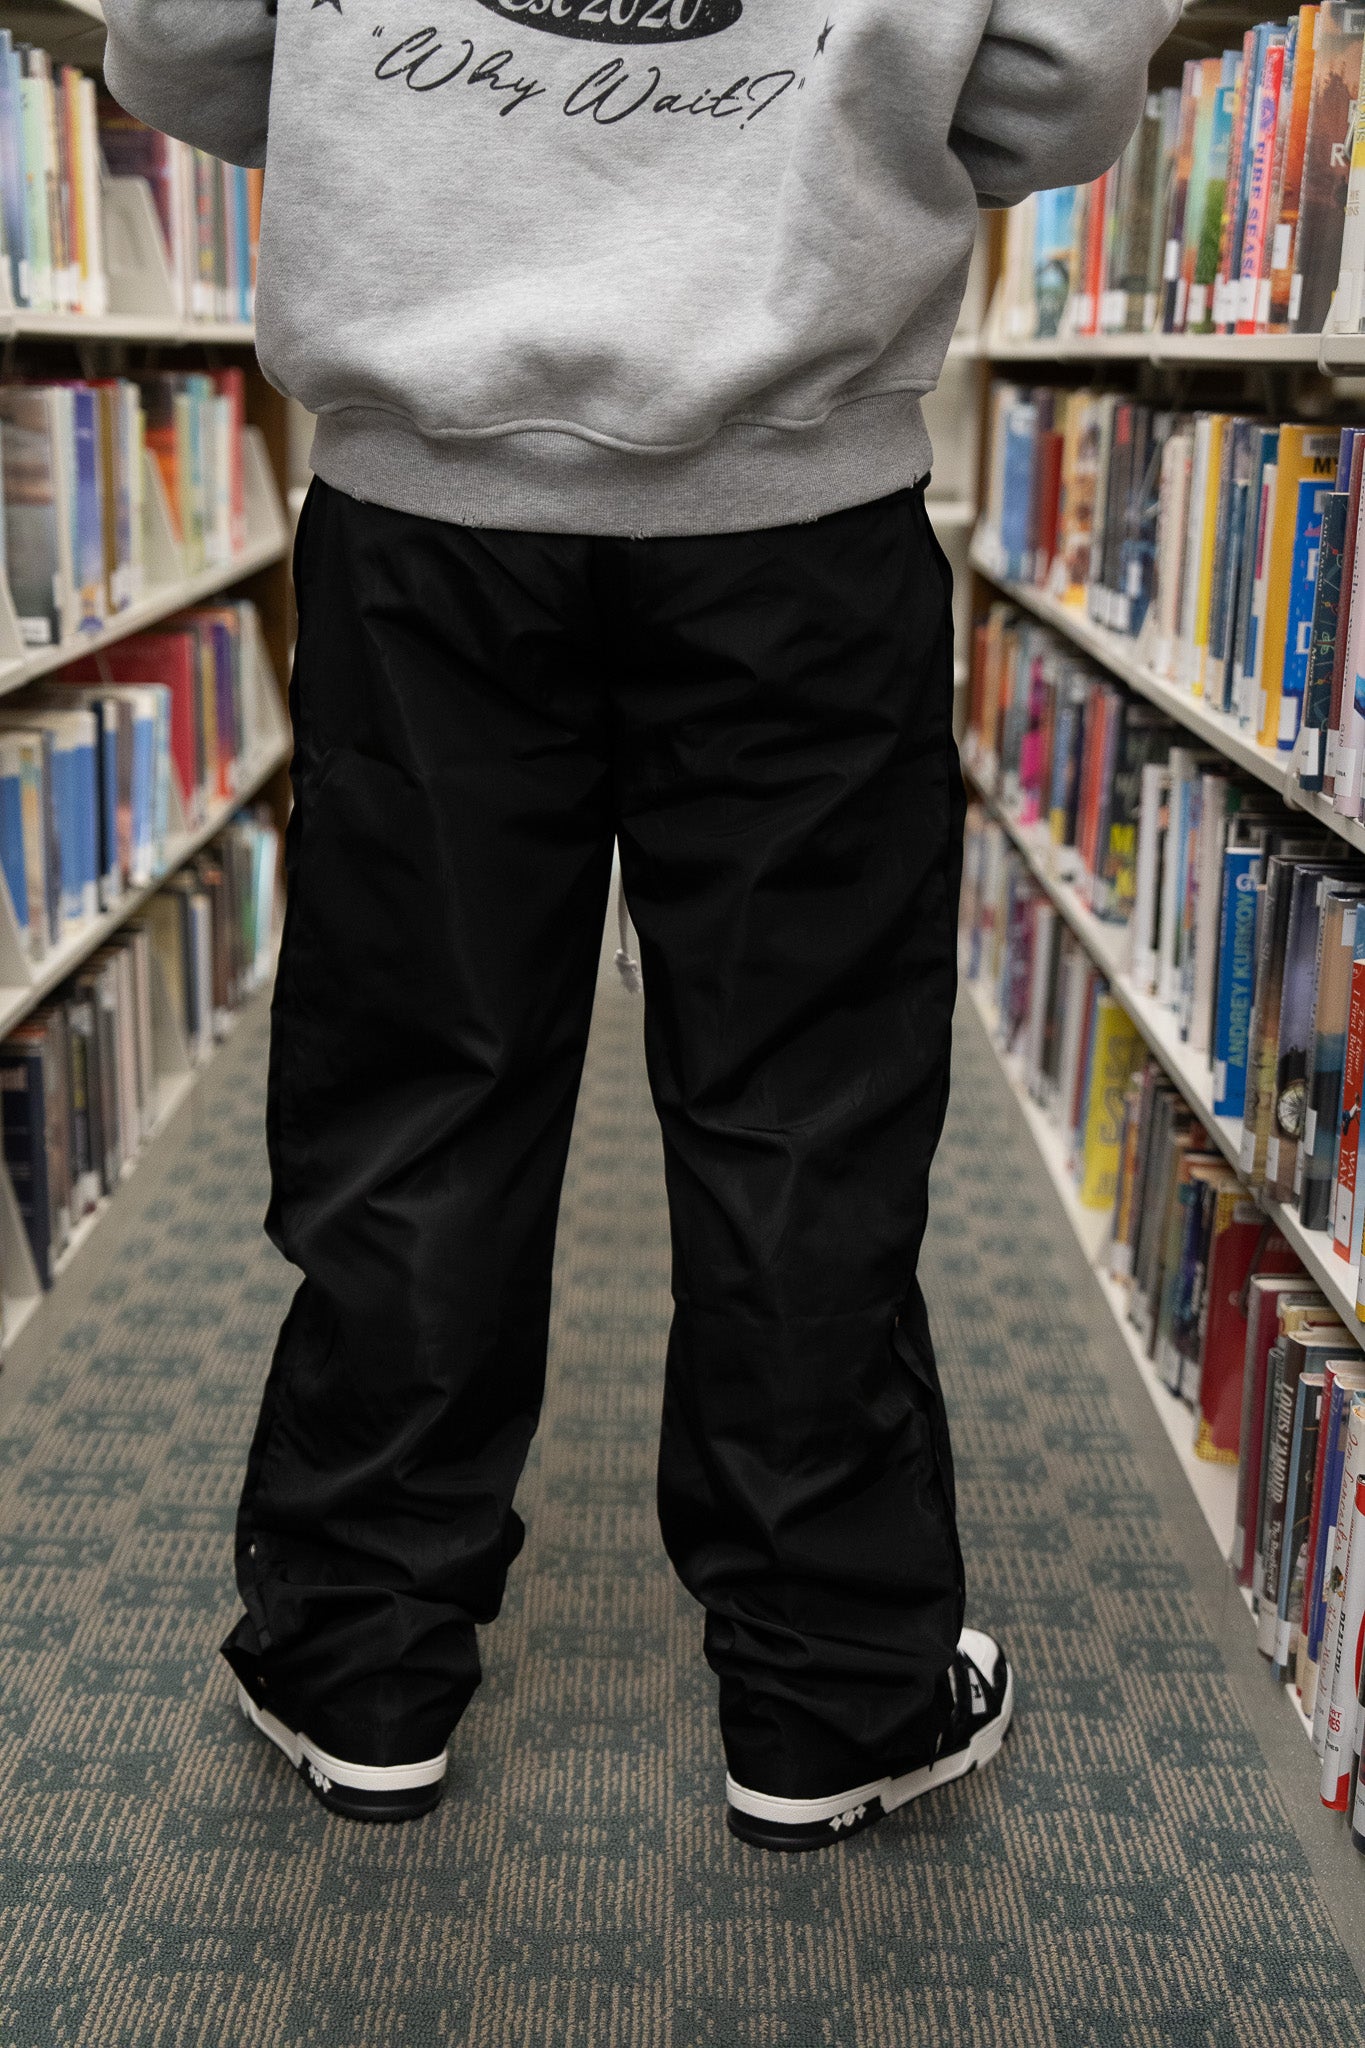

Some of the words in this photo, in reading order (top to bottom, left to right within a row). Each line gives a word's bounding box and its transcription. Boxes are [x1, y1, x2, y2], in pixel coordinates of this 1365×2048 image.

[1241, 207, 1259, 278] SEAS
[1232, 891, 1256, 979] KURKOV
[1228, 981, 1249, 1068] ANDREY
[1350, 1000, 1360, 1029] First
[1346, 1031, 1357, 1086] Believed
[1277, 1382, 1295, 1433] LOUIS
[1335, 1466, 1354, 1552] Lancaster
